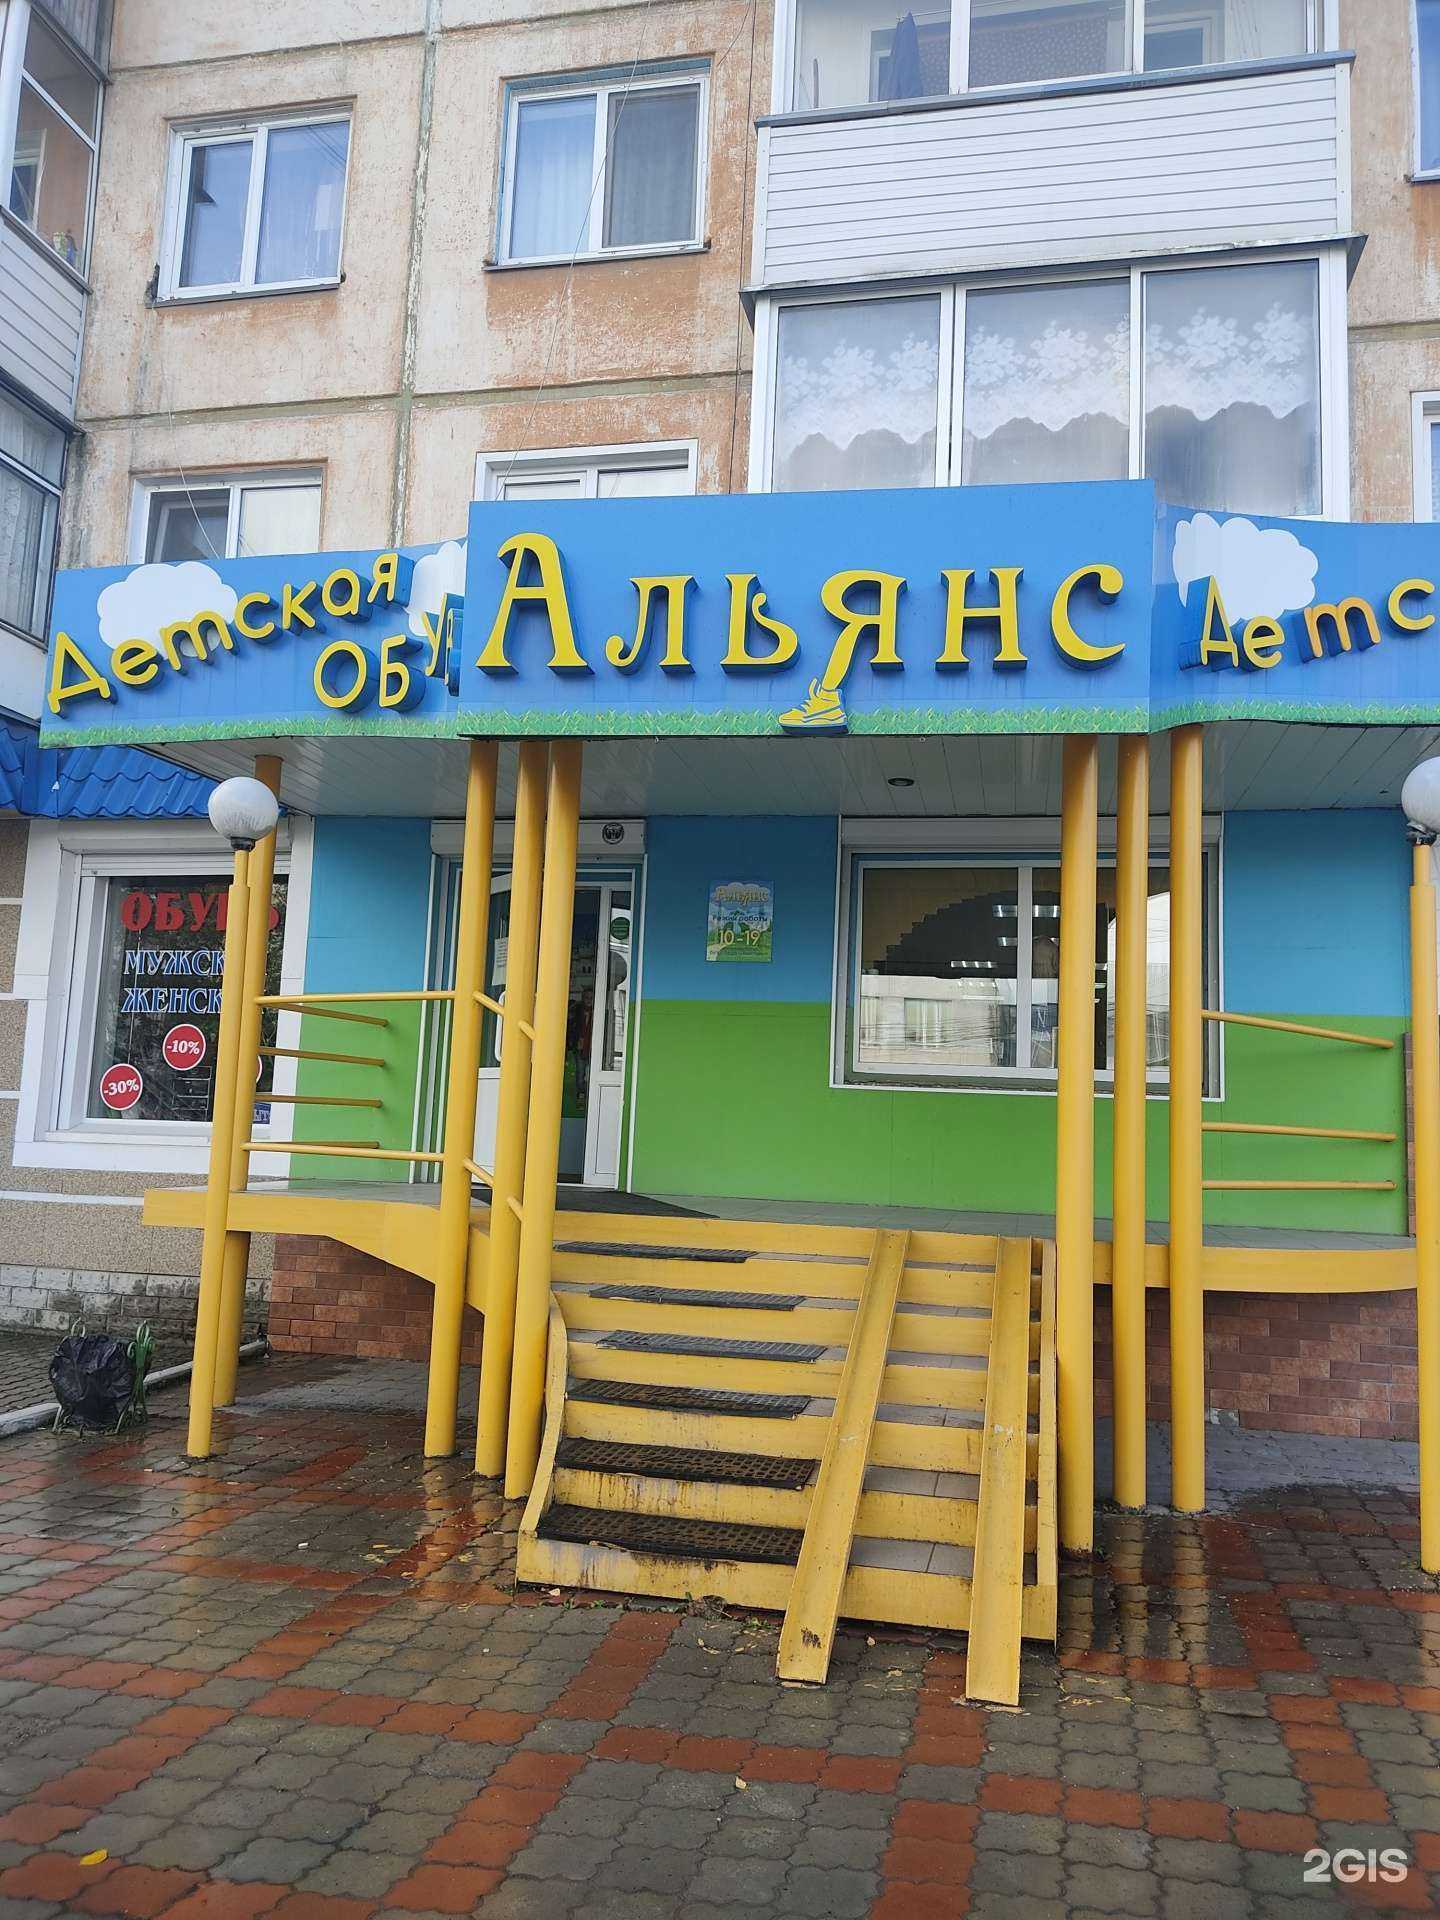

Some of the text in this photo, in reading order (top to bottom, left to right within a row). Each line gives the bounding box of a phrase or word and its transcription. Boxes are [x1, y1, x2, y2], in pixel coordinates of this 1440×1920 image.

[48, 552, 399, 714] Детская
[166, 1040, 200, 1055] -10%
[103, 1078, 140, 1096] -30%
